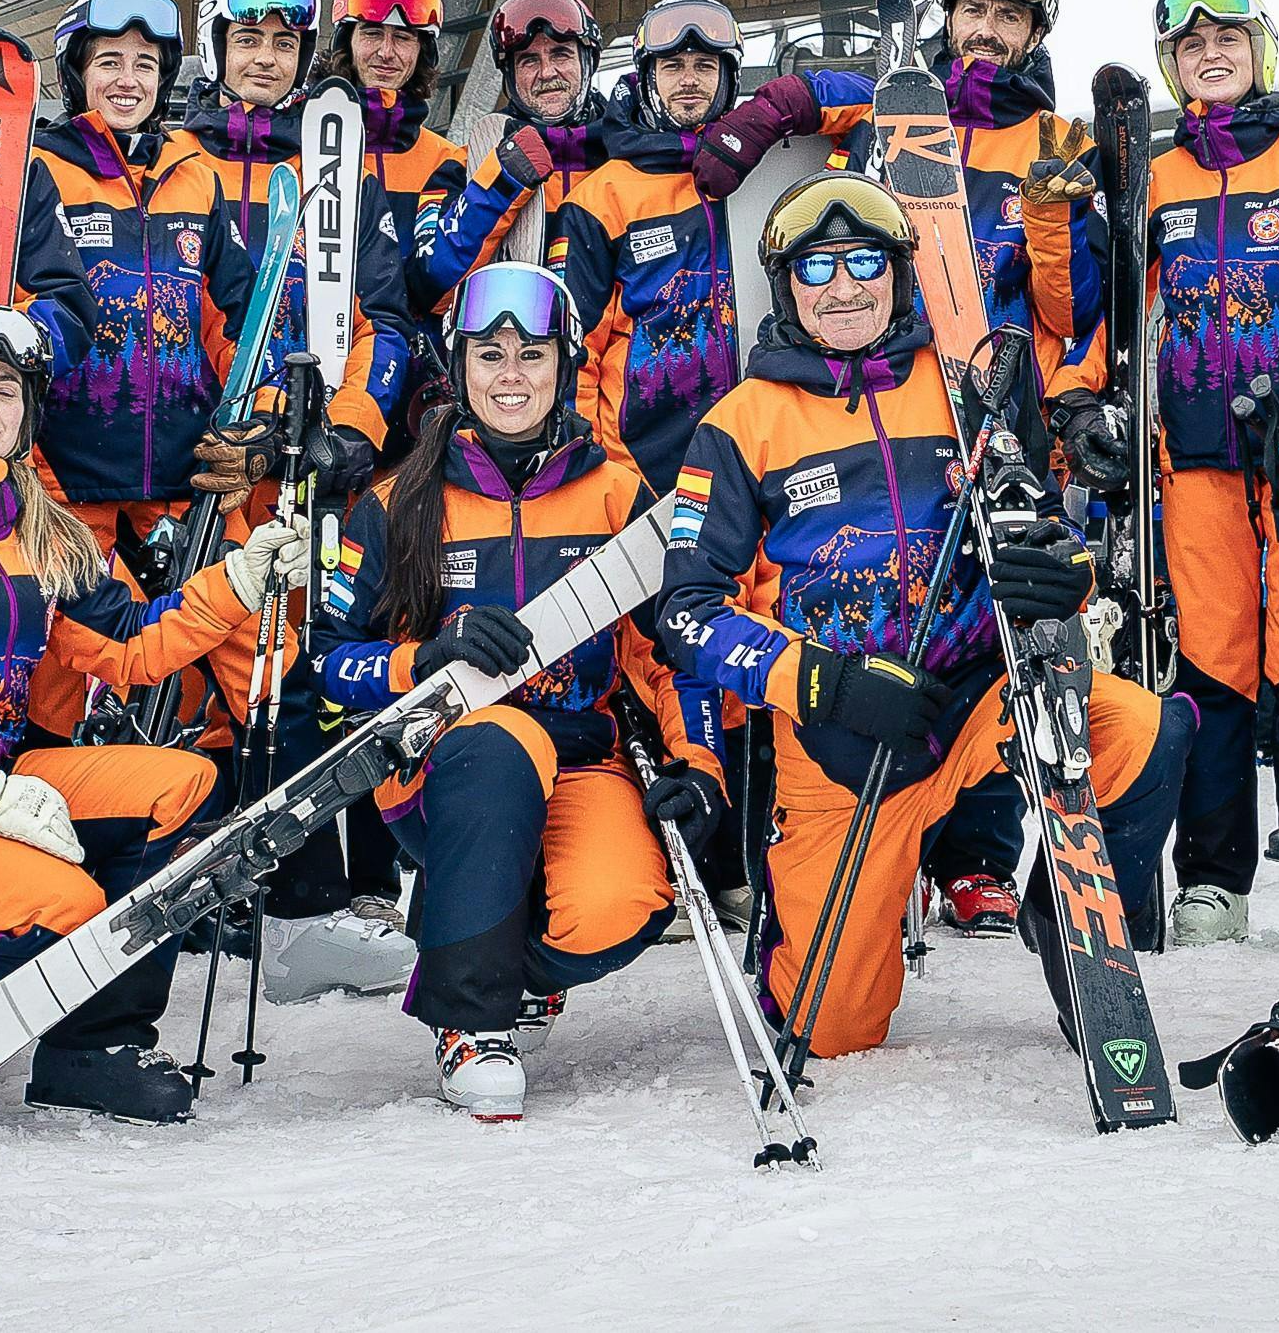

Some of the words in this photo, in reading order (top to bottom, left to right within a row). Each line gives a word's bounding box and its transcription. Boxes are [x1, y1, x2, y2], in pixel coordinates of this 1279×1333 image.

[1118, 125, 1128, 190] DYNASTAR
[319, 113, 343, 283] HEAD
[1244, 201, 1264, 210] SKI
[167, 222, 184, 231] SKI
[189, 222, 205, 231] LIFE
[643, 234, 671, 247] ULLER
[646, 243, 675, 258] Suntribe
[934, 448, 954, 458] SKI
[799, 478, 836, 493] ULLER
[559, 547, 581, 557] SKI
[259, 589, 275, 646] ROSSIGNOL
[276, 590, 289, 645] ROSSIGNOL
[667, 611, 715, 648] SKI
[1108, 1042, 1142, 1053] ROSSIGNOL
